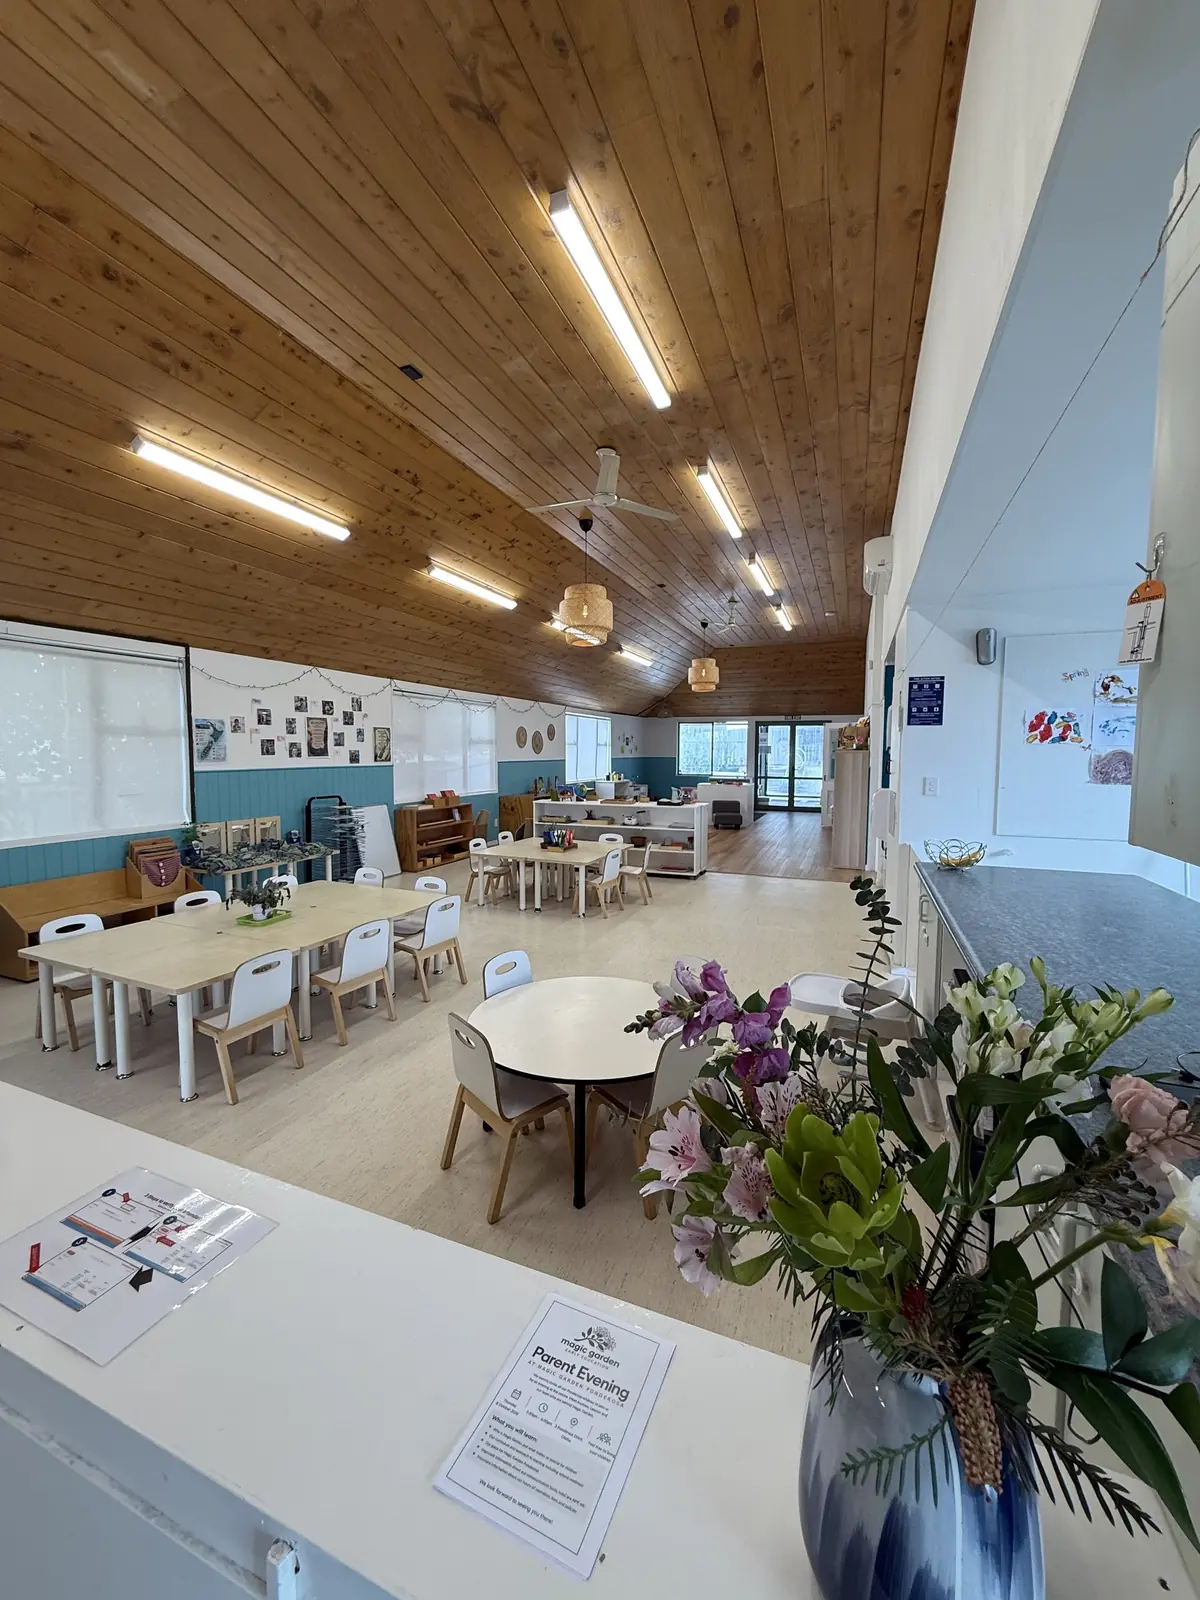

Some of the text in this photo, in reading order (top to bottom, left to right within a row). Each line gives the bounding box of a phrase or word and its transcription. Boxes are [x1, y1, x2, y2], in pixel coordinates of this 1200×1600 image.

[1129, 593, 1163, 604] ADJUSTMENT
[1062, 668, 1089, 681] Spring
[561, 1338, 619, 1368] magic garden
[532, 1346, 630, 1402] Parent Evening
[538, 1365, 556, 1376] MAGIC
[559, 1375, 583, 1388] GARDEN
[586, 1387, 623, 1408] PONDEROSA
[492, 1415, 505, 1425] What
[523, 1432, 538, 1442] learn:
[496, 1488, 513, 1501] forward
[517, 1502, 531, 1513] seeing
